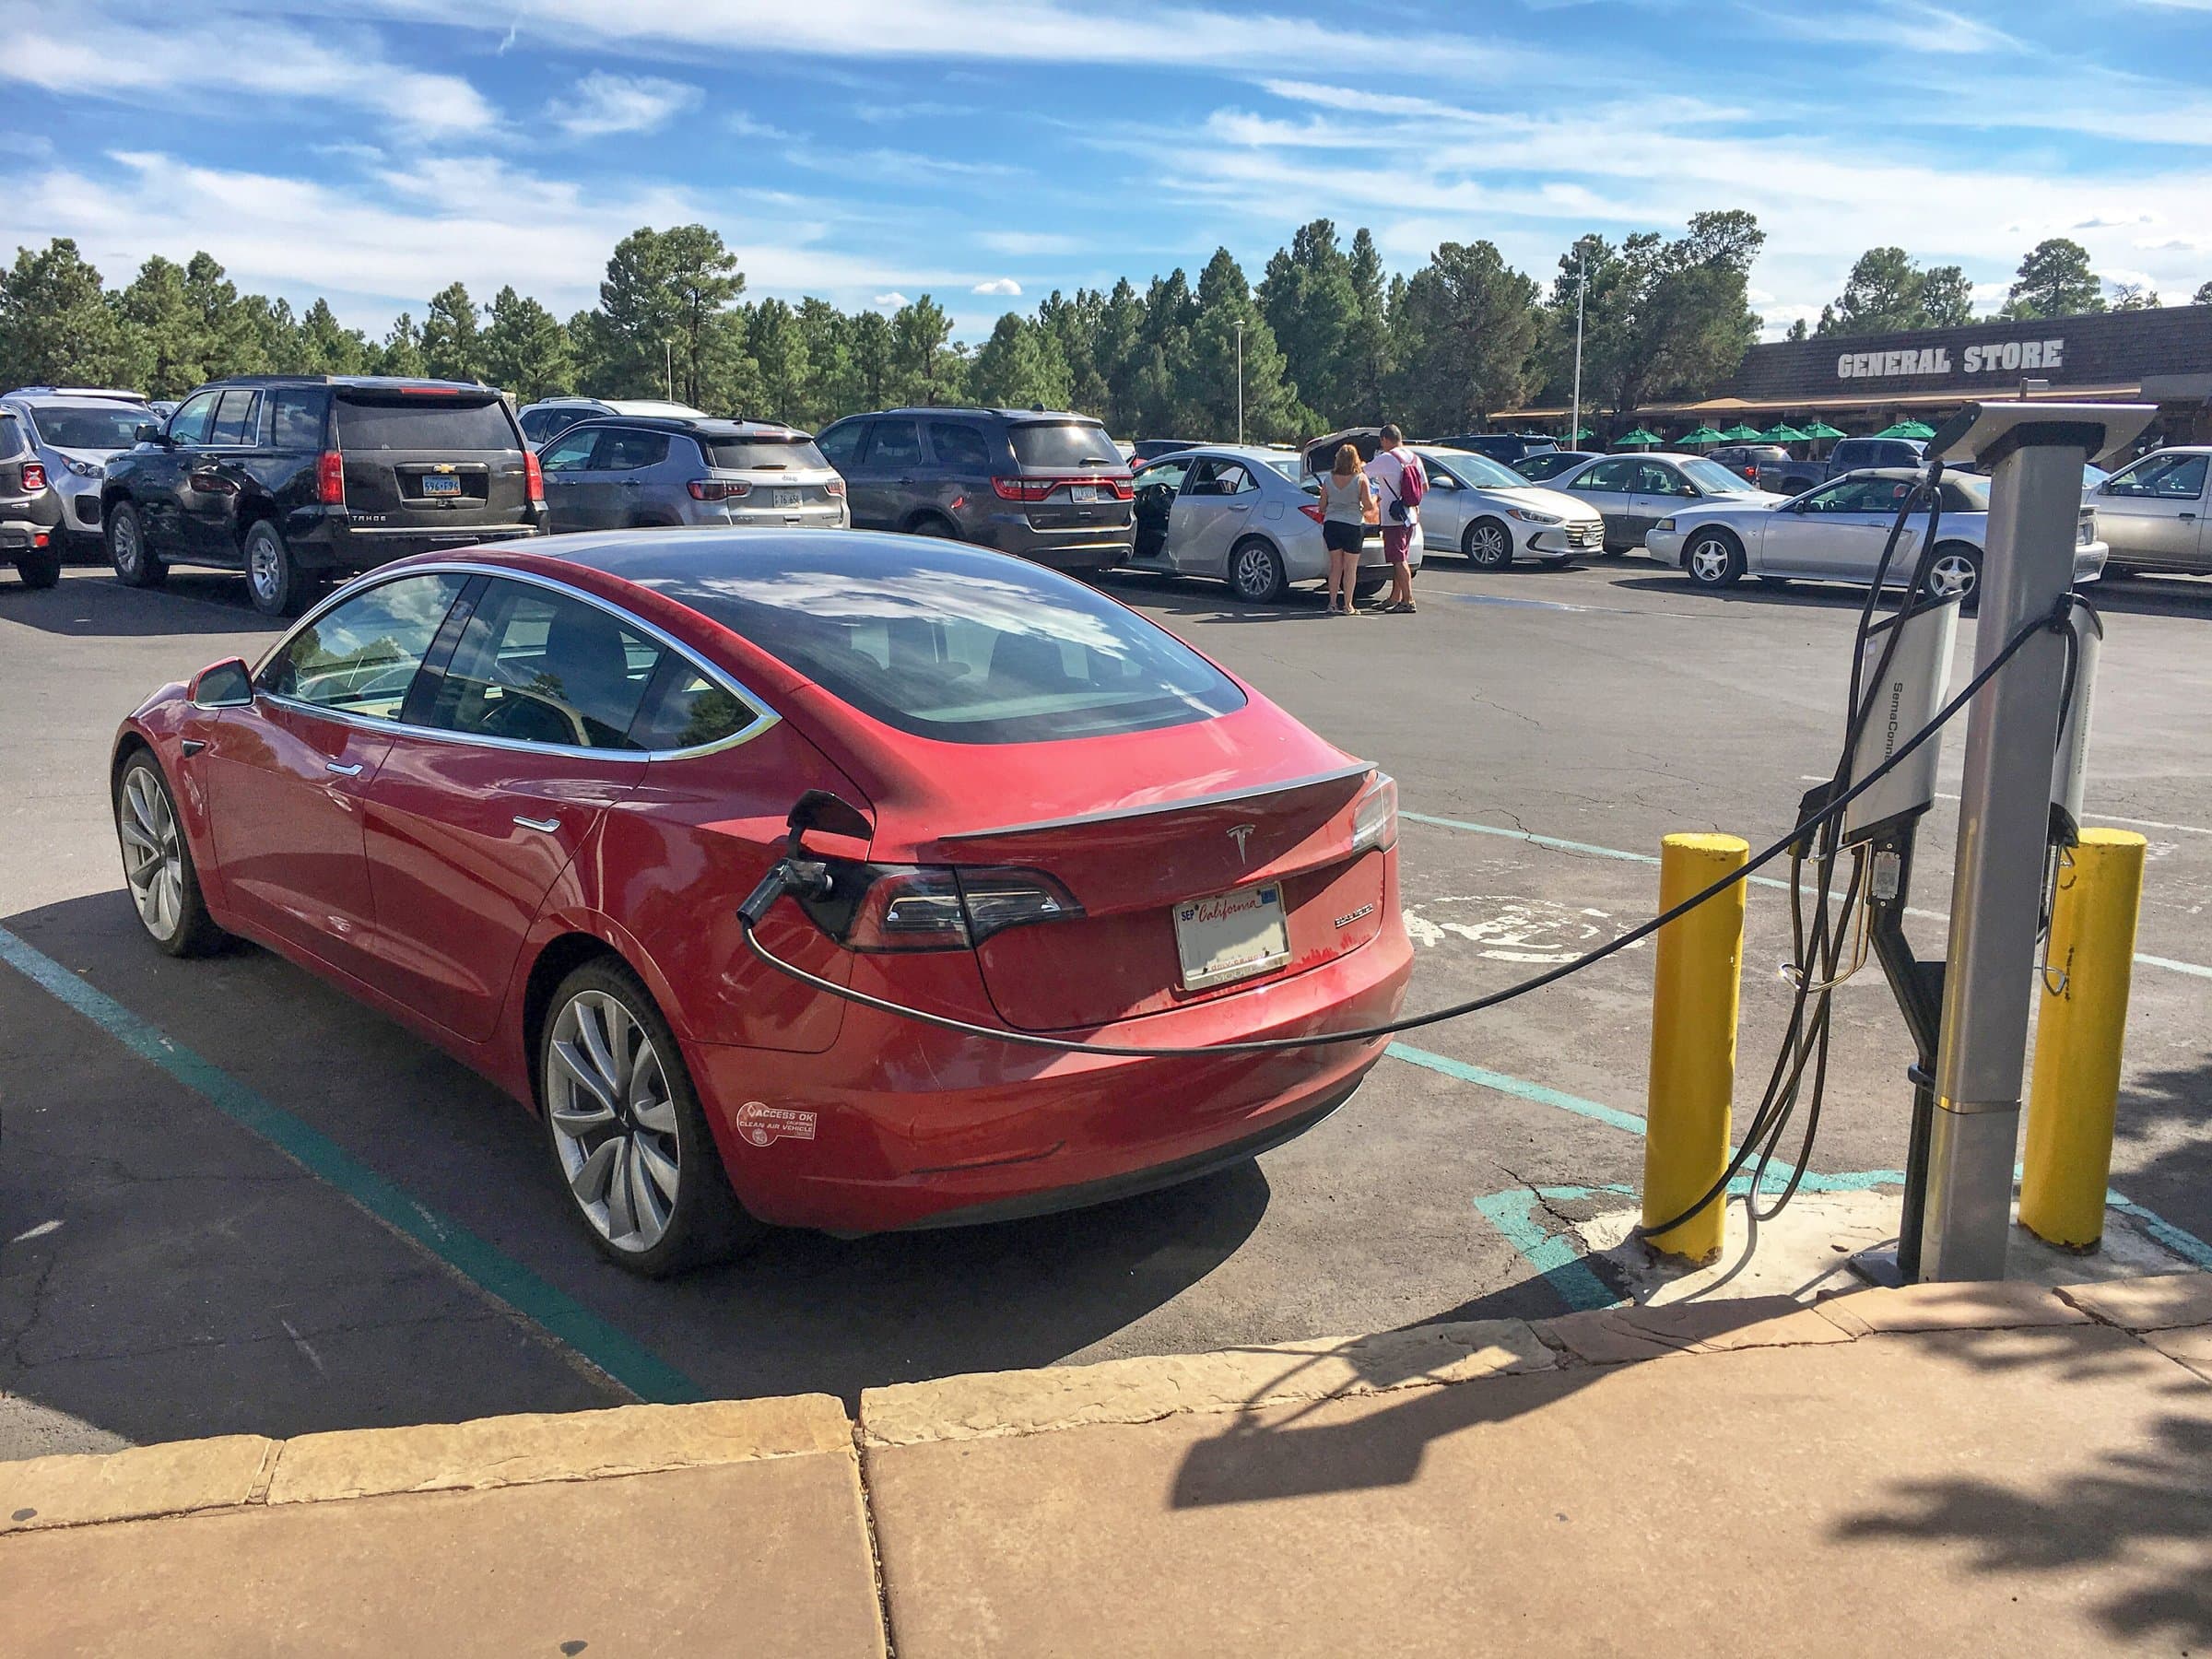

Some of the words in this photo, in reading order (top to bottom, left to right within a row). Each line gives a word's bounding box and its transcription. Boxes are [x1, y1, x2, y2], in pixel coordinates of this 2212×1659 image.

[1837, 347, 1953, 378] GENERAL
[1963, 339, 2065, 373] STORE
[1181, 909, 1194, 922] SEP
[1199, 900, 1263, 923] California
[756, 1110, 796, 1120] ACCESS
